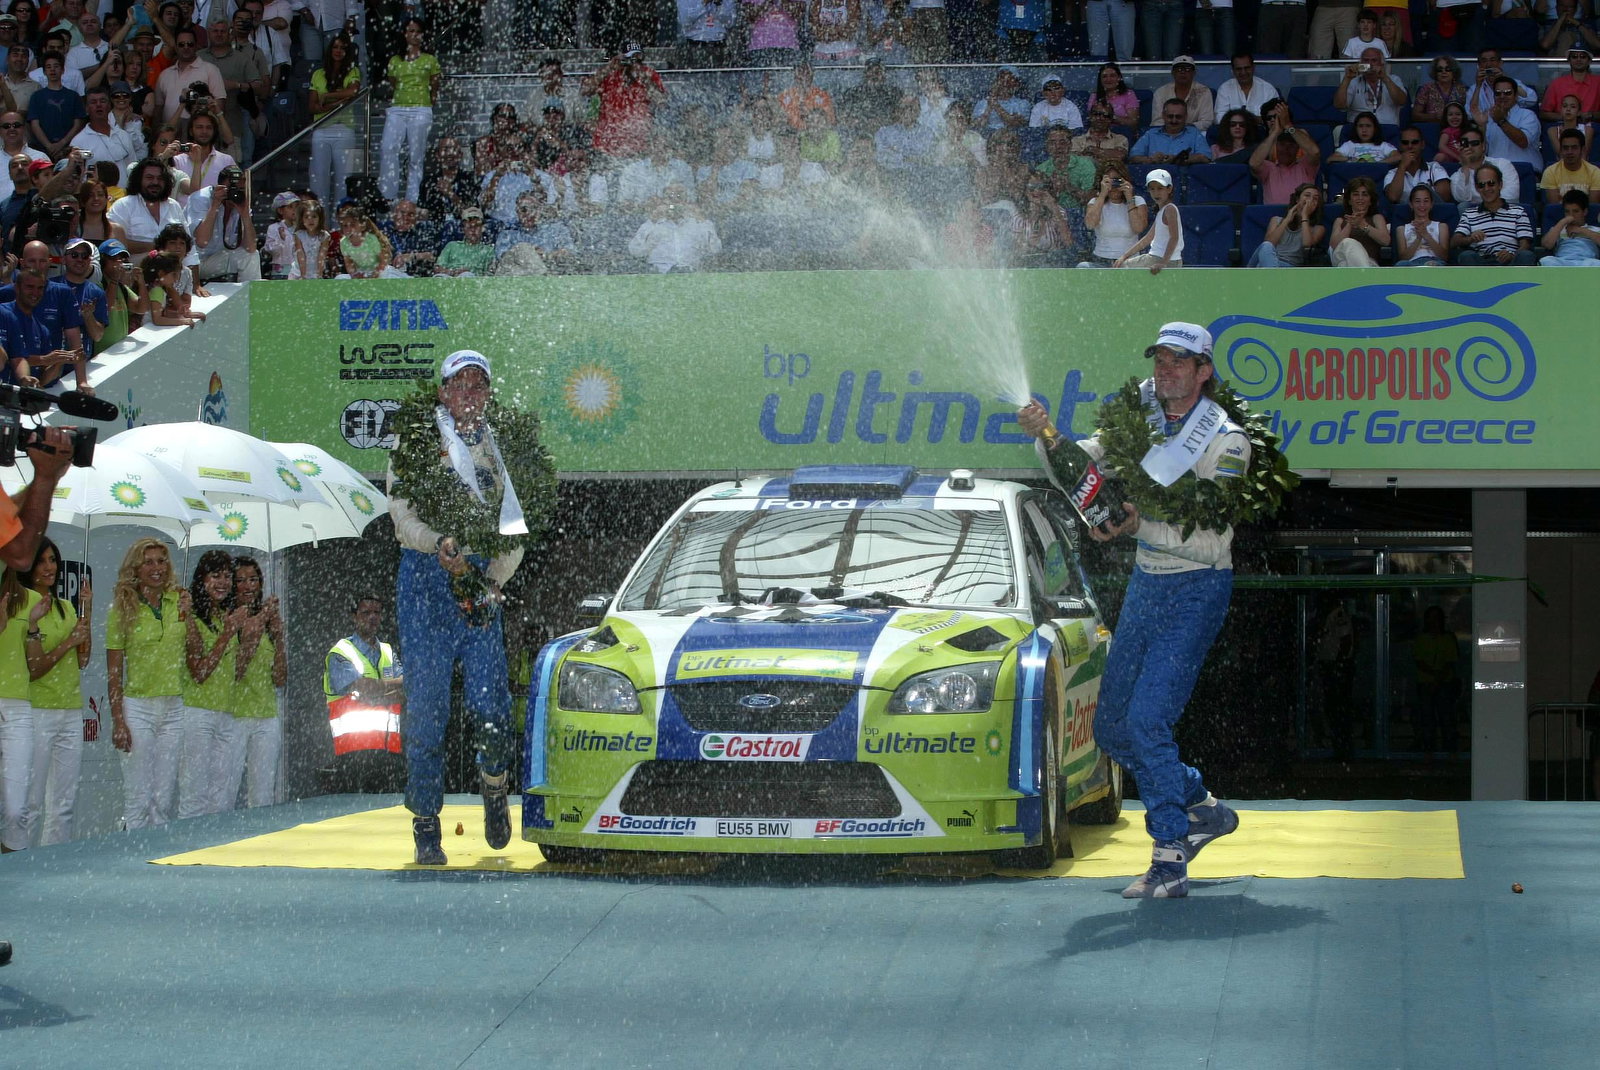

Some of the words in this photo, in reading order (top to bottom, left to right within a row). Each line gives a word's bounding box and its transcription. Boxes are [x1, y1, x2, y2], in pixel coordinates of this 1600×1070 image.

[339, 343, 435, 365] WRC
[763, 343, 811, 386] bp
[1284, 347, 1452, 401] ACROPOLIS
[758, 369, 1124, 445] ultimat
[1182, 414, 1215, 456] RALLY
[1308, 409, 1360, 445] of
[1363, 409, 1537, 445] Greece
[1071, 473, 1098, 508] ZANO
[760, 498, 858, 510] Ford
[683, 655, 788, 672] ultimat
[563, 729, 653, 752] ultimate
[864, 725, 880, 737] bp
[725, 736, 802, 758] Castrol
[864, 731, 977, 754] ultimate
[598, 815, 697, 831] BFGoodrich
[718, 821, 754, 836] EU55
[757, 822, 790, 836] BMV
[814, 818, 926, 834] BFGoodrich
[946, 817, 972, 827] PUMA
